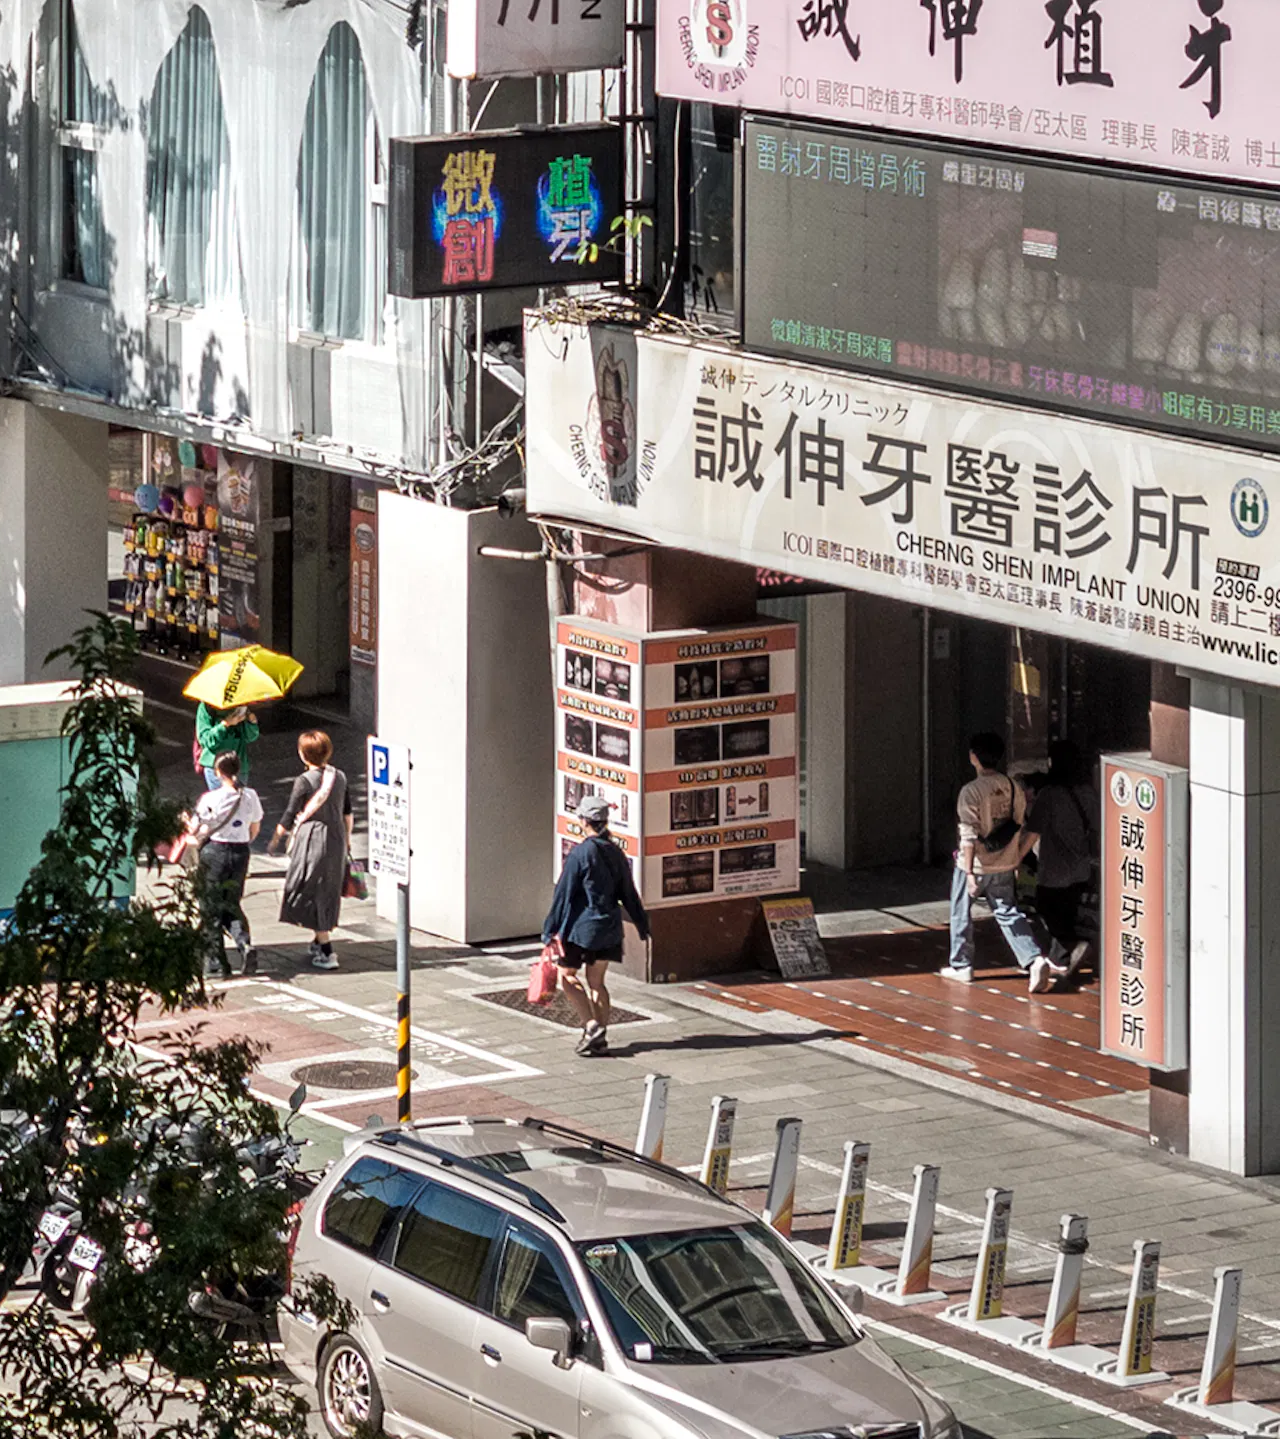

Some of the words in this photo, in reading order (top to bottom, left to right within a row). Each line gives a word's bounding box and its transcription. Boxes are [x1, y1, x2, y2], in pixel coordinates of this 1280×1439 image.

[780, 74, 810, 101] ICOI
[1101, 118, 1158, 155] 理事長
[756, 134, 927, 198] 雷射牙周增骨術
[441, 149, 497, 285] 微創
[548, 154, 593, 263] 植牙
[692, 396, 1211, 591] 誠伸牙醫診所
[783, 531, 813, 557] ICOI
[896, 530, 974, 569] CHERNG
[982, 549, 1033, 581] SHEN
[1042, 563, 1127, 604] IMPLANT
[1136, 586, 1200, 620] UNION
[1201, 634, 1280, 665] www.lic
[1210, 600, 1280, 637] 請上二樓
[374, 749, 387, 779] P
[1119, 815, 1146, 1050] 誠伸牙醫診所
